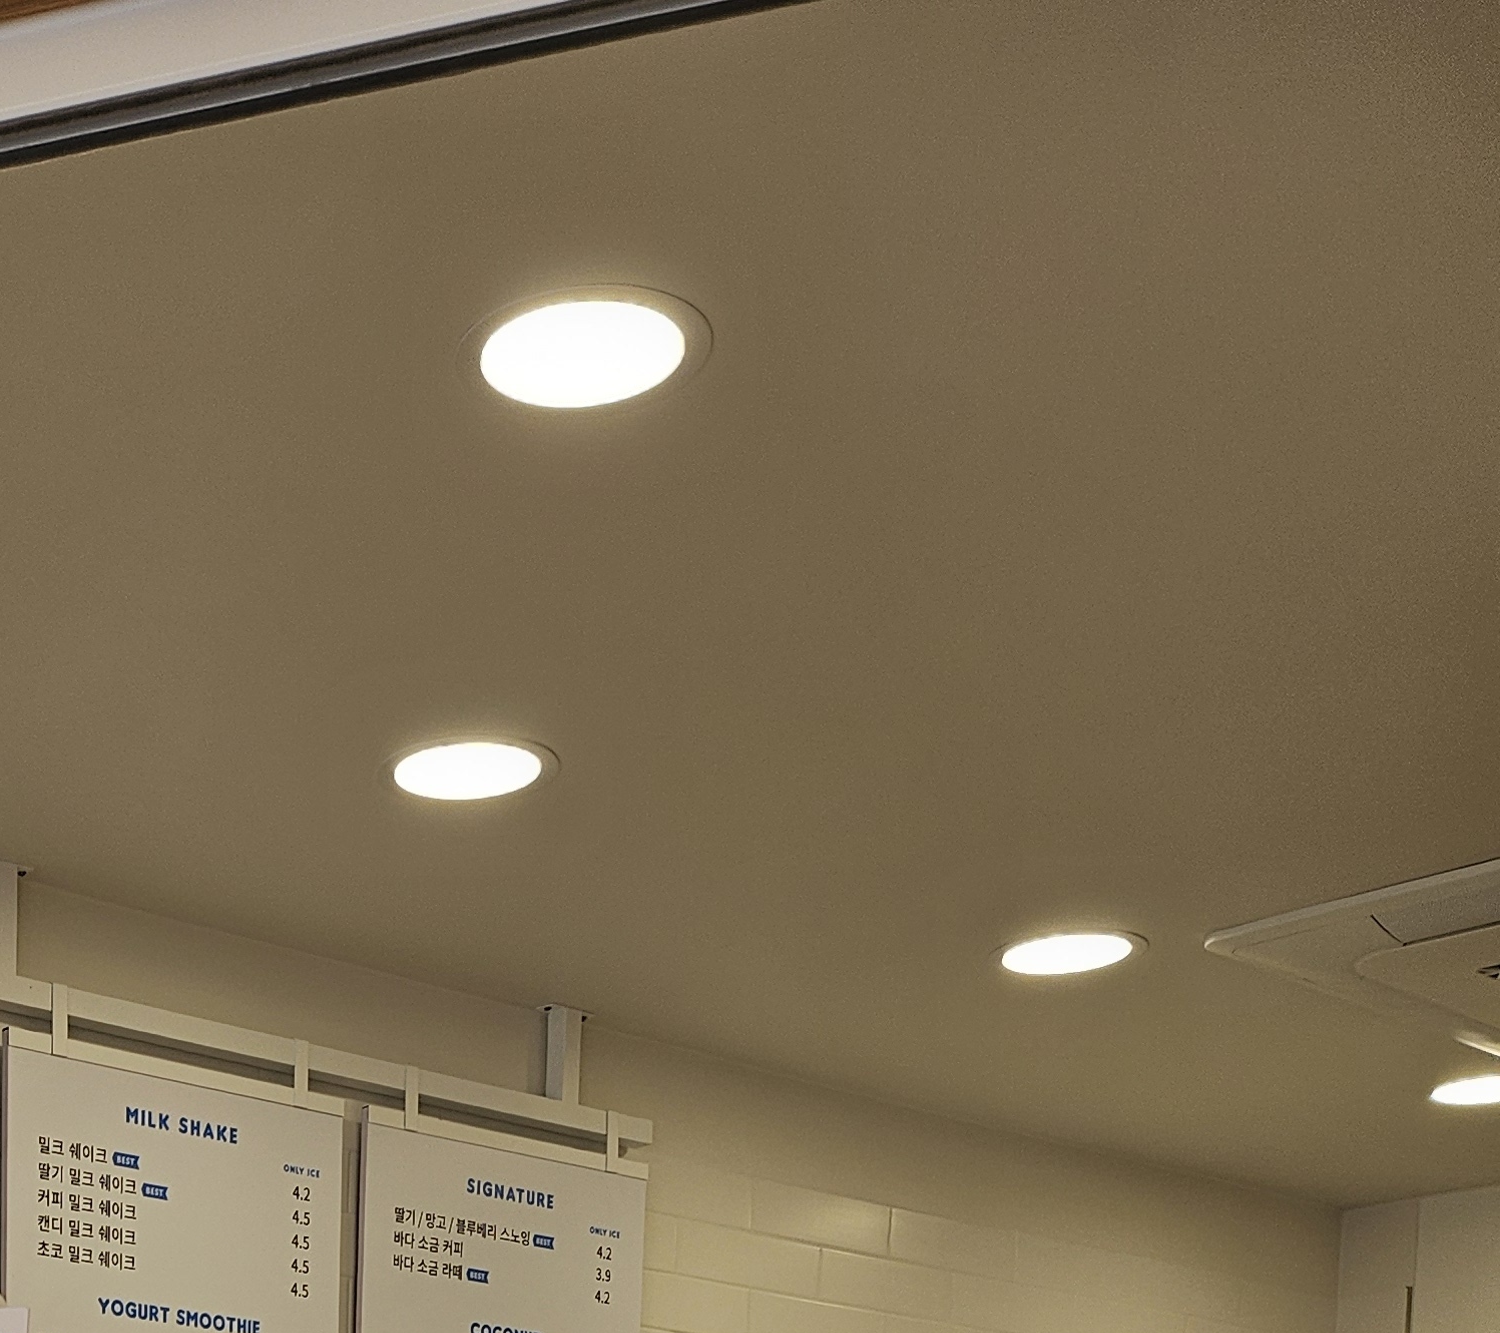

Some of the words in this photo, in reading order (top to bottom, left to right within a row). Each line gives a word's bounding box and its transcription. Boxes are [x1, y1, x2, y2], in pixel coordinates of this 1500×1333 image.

[126, 1107, 170, 1131] MILK
[179, 1117, 238, 1145] SHAKE
[38, 1136, 64, 1156] 밀크
[69, 1143, 108, 1164] 쉐이크
[38, 1163, 63, 1183] 딸기
[69, 1169, 94, 1187] 밀크
[99, 1173, 137, 1195] 쉐이크
[284, 1164, 304, 1176] ONLY
[292, 1187, 311, 1202] 4.2
[467, 1178, 554, 1209] SIGNATURE
[292, 1211, 311, 1226] 4.5
[394, 1207, 416, 1225] 딸기
[426, 1212, 446, 1230] 망고
[456, 1218, 496, 1240] 블루베리
[500, 1228, 530, 1246] 스노잉
[394, 1232, 415, 1248] 바다
[418, 1237, 439, 1252] 소금
[443, 1240, 463, 1257] 커피
[596, 1268, 611, 1282] 3.9
[98, 1298, 170, 1324] YOGURT
